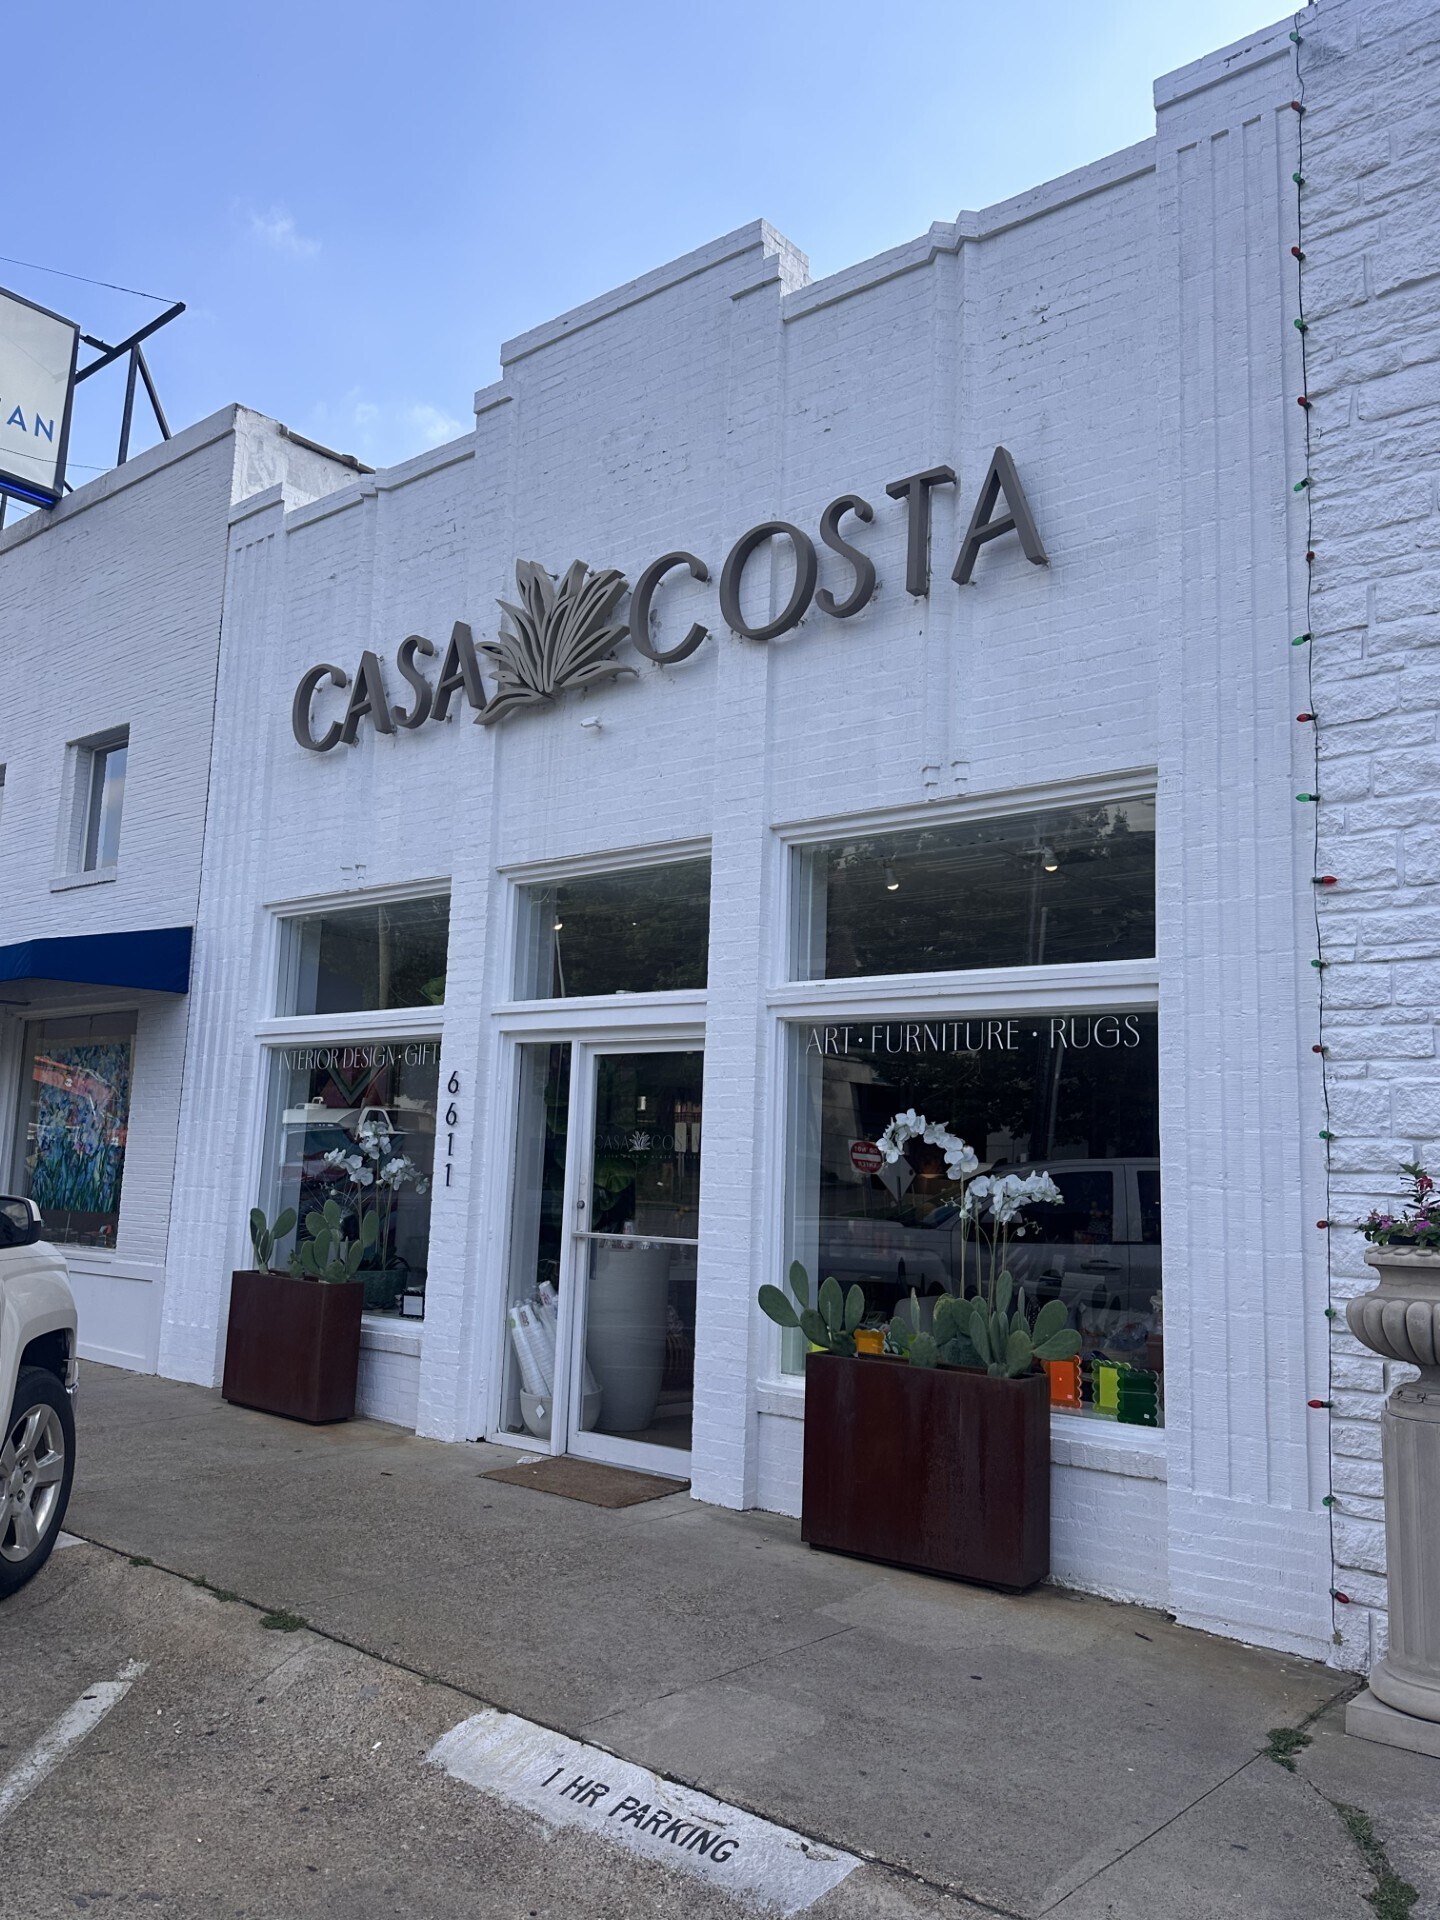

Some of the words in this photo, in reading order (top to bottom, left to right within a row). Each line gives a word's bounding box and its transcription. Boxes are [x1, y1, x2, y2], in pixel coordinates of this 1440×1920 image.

[0, 397, 54, 443] AN
[292, 621, 486, 752] CASA
[629, 445, 1048, 664] COSTA
[279, 1048, 339, 1071] INTERIOR
[343, 1045, 395, 1068] DESIGN
[405, 1043, 440, 1067] GIFT
[805, 1026, 853, 1055] ART
[872, 1019, 1019, 1054] FURNITURE
[1050, 1015, 1141, 1049] RUGS
[445, 1070, 459, 1187] 6611
[595, 1134, 629, 1150] CASA
[540, 1767, 565, 1788] 1
[558, 1774, 610, 1808] HR
[608, 1796, 740, 1863] PARKING
